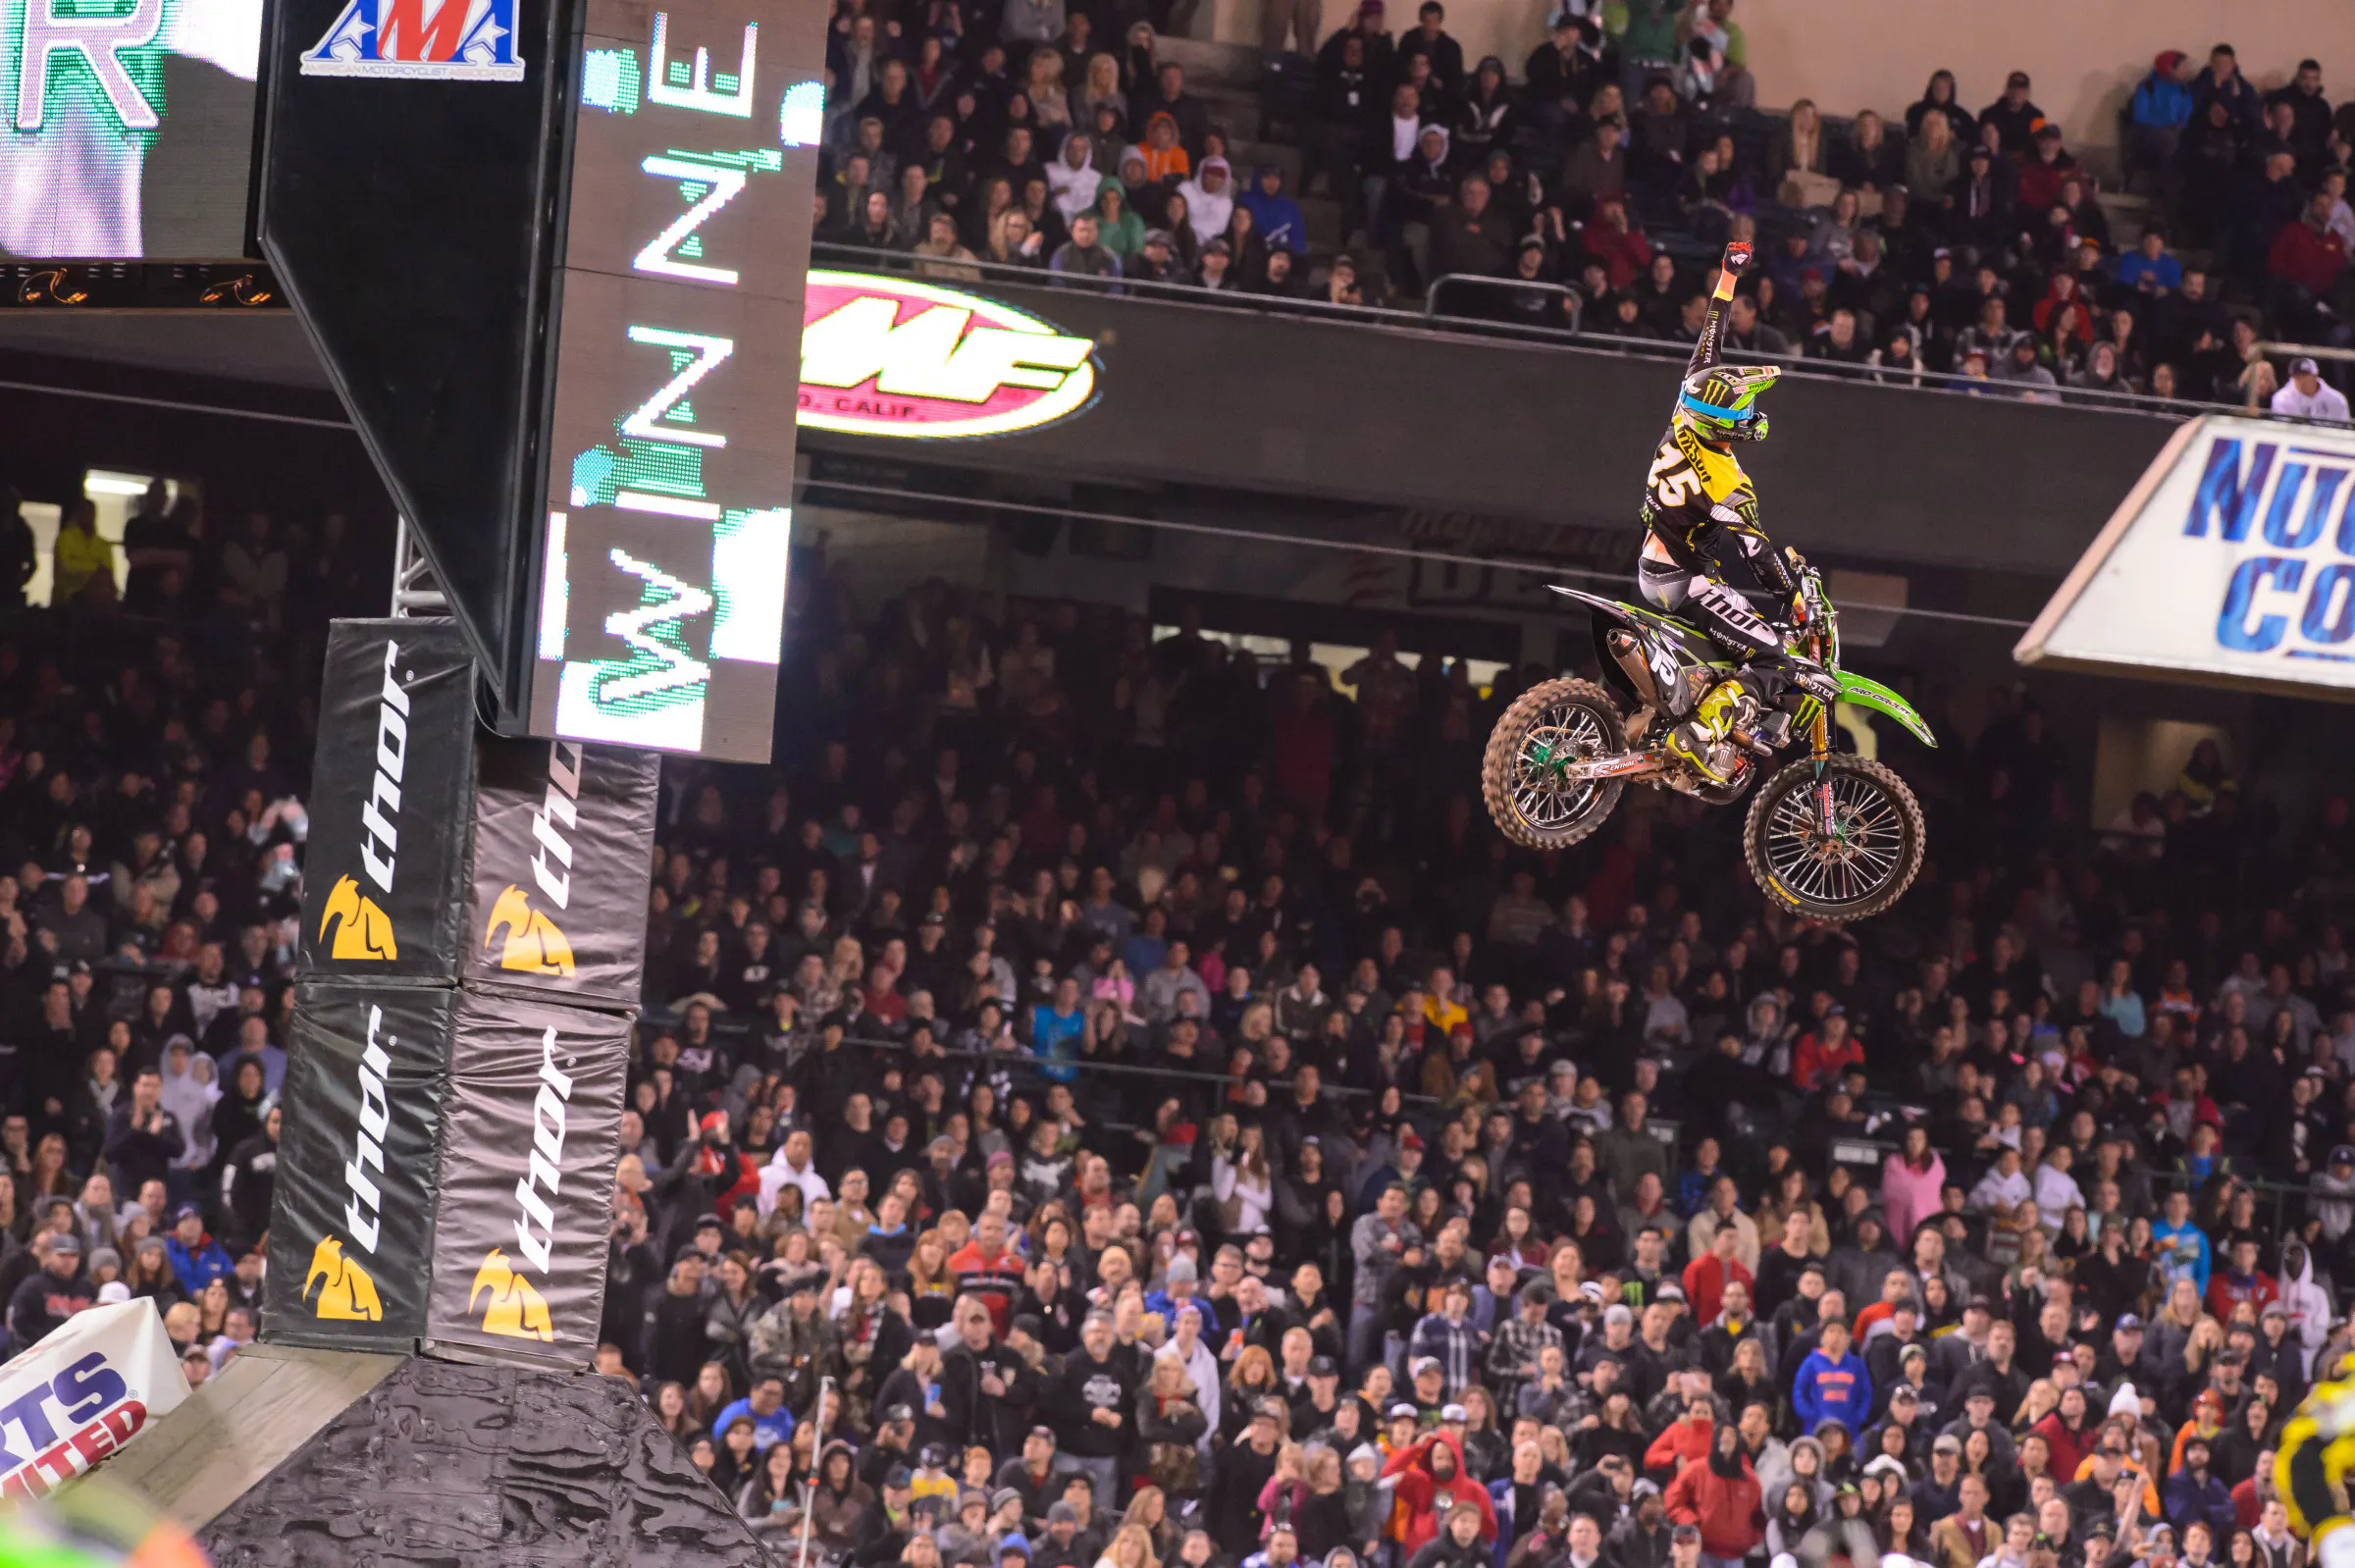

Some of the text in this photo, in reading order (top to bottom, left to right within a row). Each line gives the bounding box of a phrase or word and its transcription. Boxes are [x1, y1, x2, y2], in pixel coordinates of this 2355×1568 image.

[303, 0, 522, 64] AMA
[304, 64, 522, 78] AMERICAN MOTORCYCLIST ASSOCIATION
[2182, 438, 2355, 556] NU
[360, 639, 411, 894] thor
[344, 1004, 394, 1254] thor
[513, 1024, 574, 1275] thor
